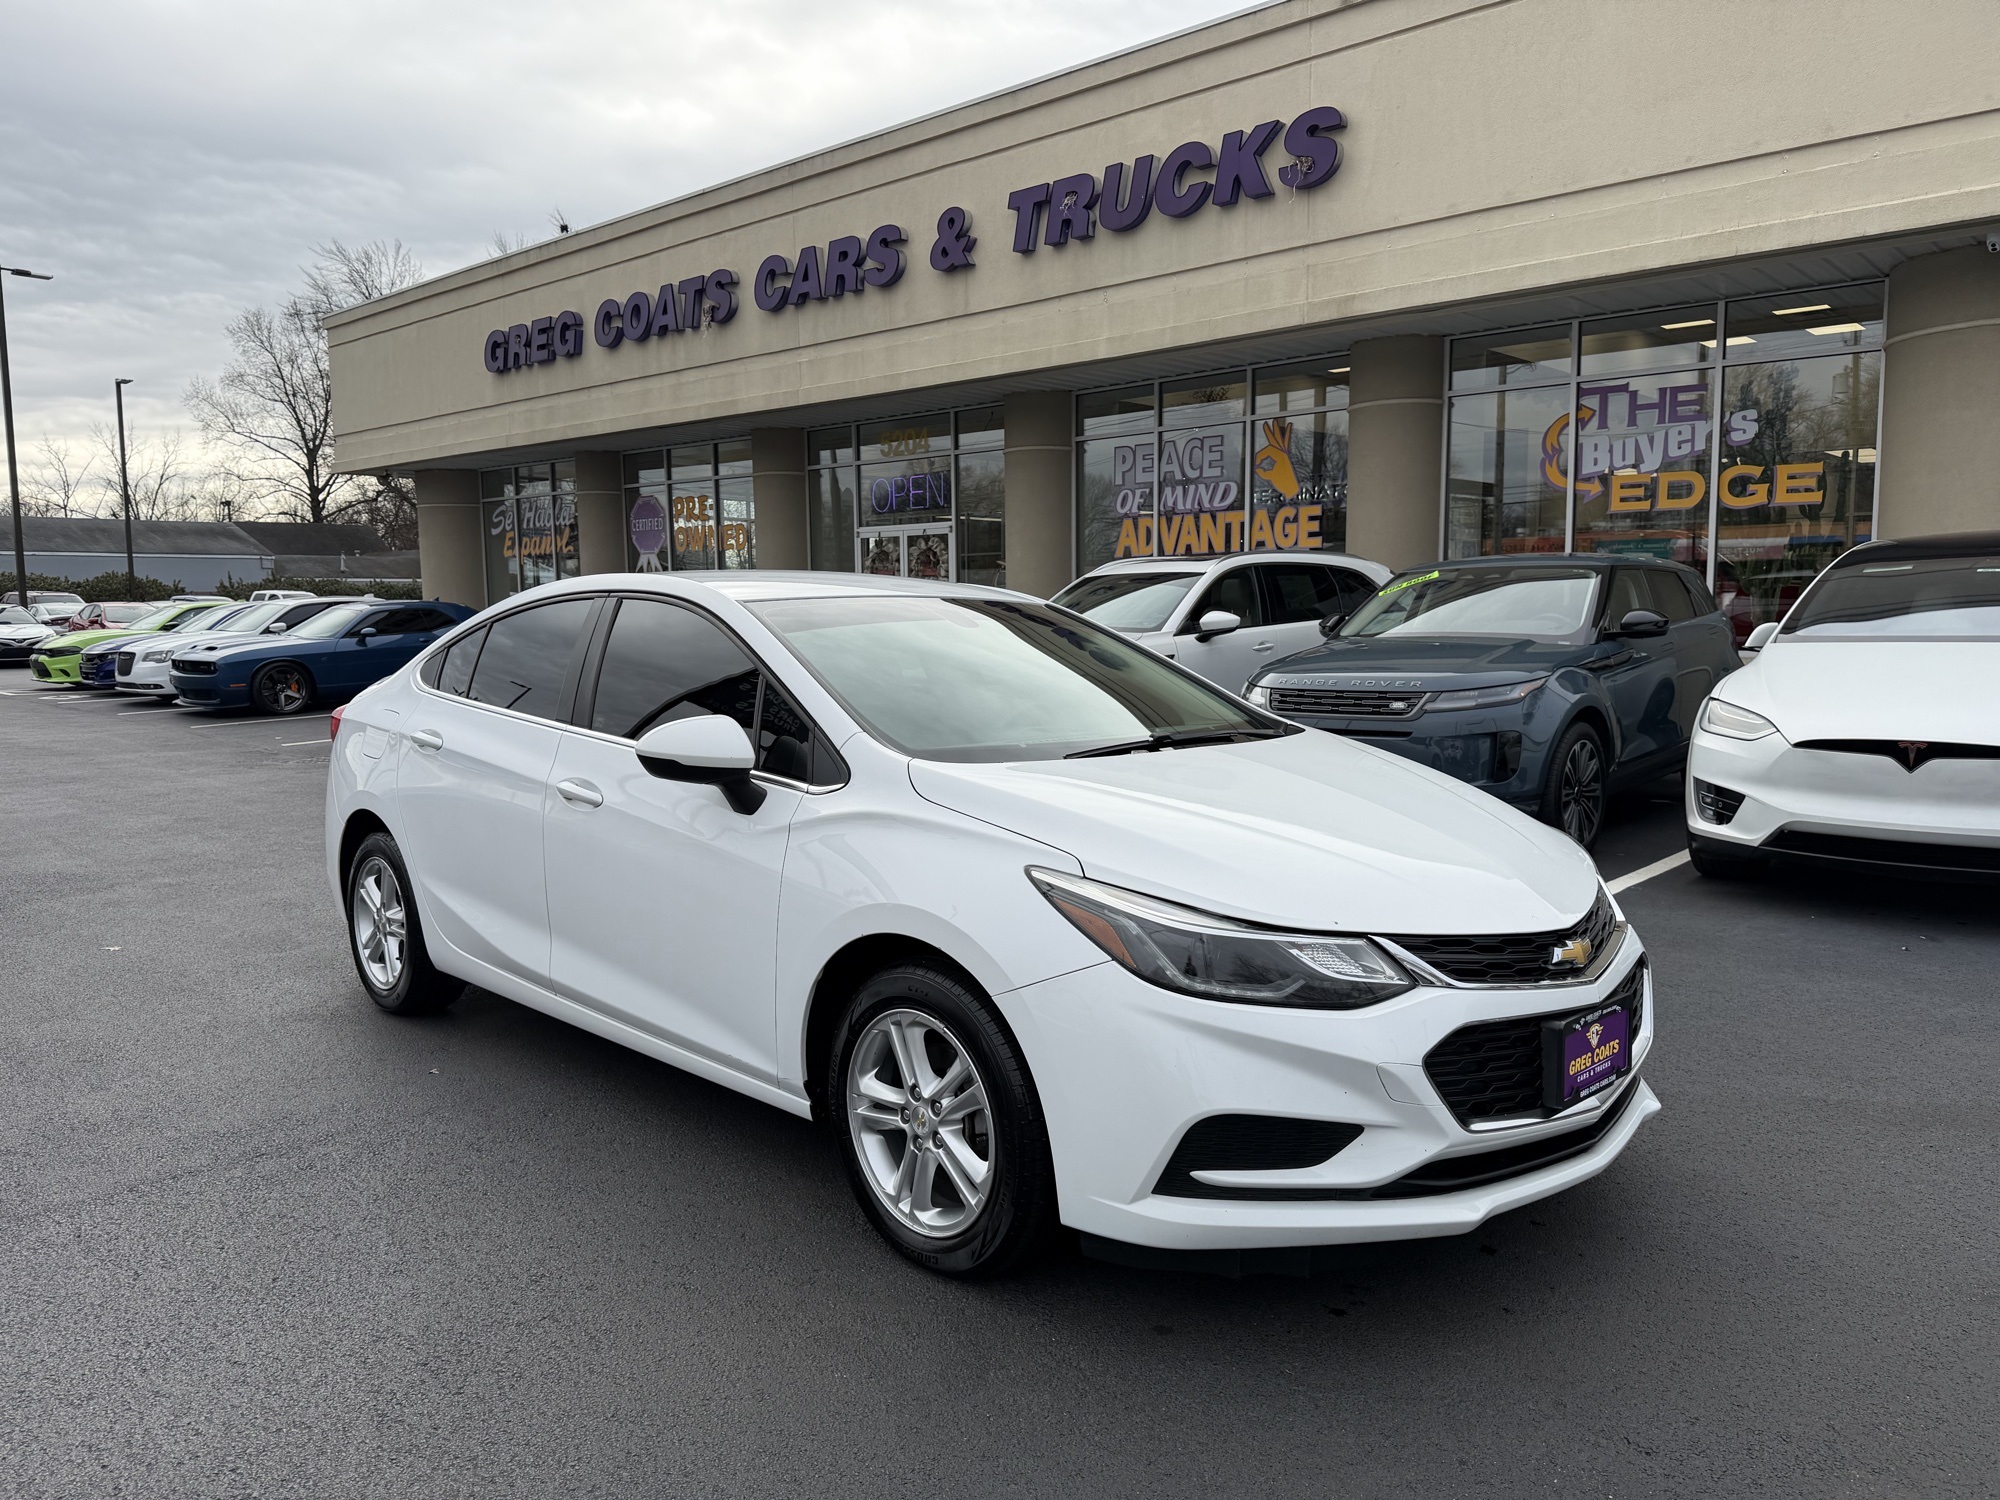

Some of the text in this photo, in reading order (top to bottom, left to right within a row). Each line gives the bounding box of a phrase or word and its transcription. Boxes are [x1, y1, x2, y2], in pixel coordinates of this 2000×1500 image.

[485, 106, 1348, 373] GREG COATS CARS & TRUCKS
[1578, 382, 1709, 431] THE
[880, 427, 930, 457] 5204
[1114, 435, 1224, 486] PEACE
[1579, 408, 1760, 479] Buyer's
[872, 472, 944, 512] OPEN
[1115, 481, 1238, 516] OF MIND
[1607, 462, 1824, 514] EDGE
[491, 498, 574, 535] Se Habla
[631, 518, 664, 532] CERTIFIED
[673, 495, 714, 523] PRE-
[503, 527, 574, 566] Epañl
[674, 523, 748, 553] OWNED
[1114, 504, 1323, 558] ADVANTAGE
[1278, 678, 1422, 688] RANGE ROVER
[1569, 1039, 1619, 1075] GREG COATS
[1577, 1071, 1589, 1083] CARS
[1594, 1060, 1611, 1074] TRUCKS
